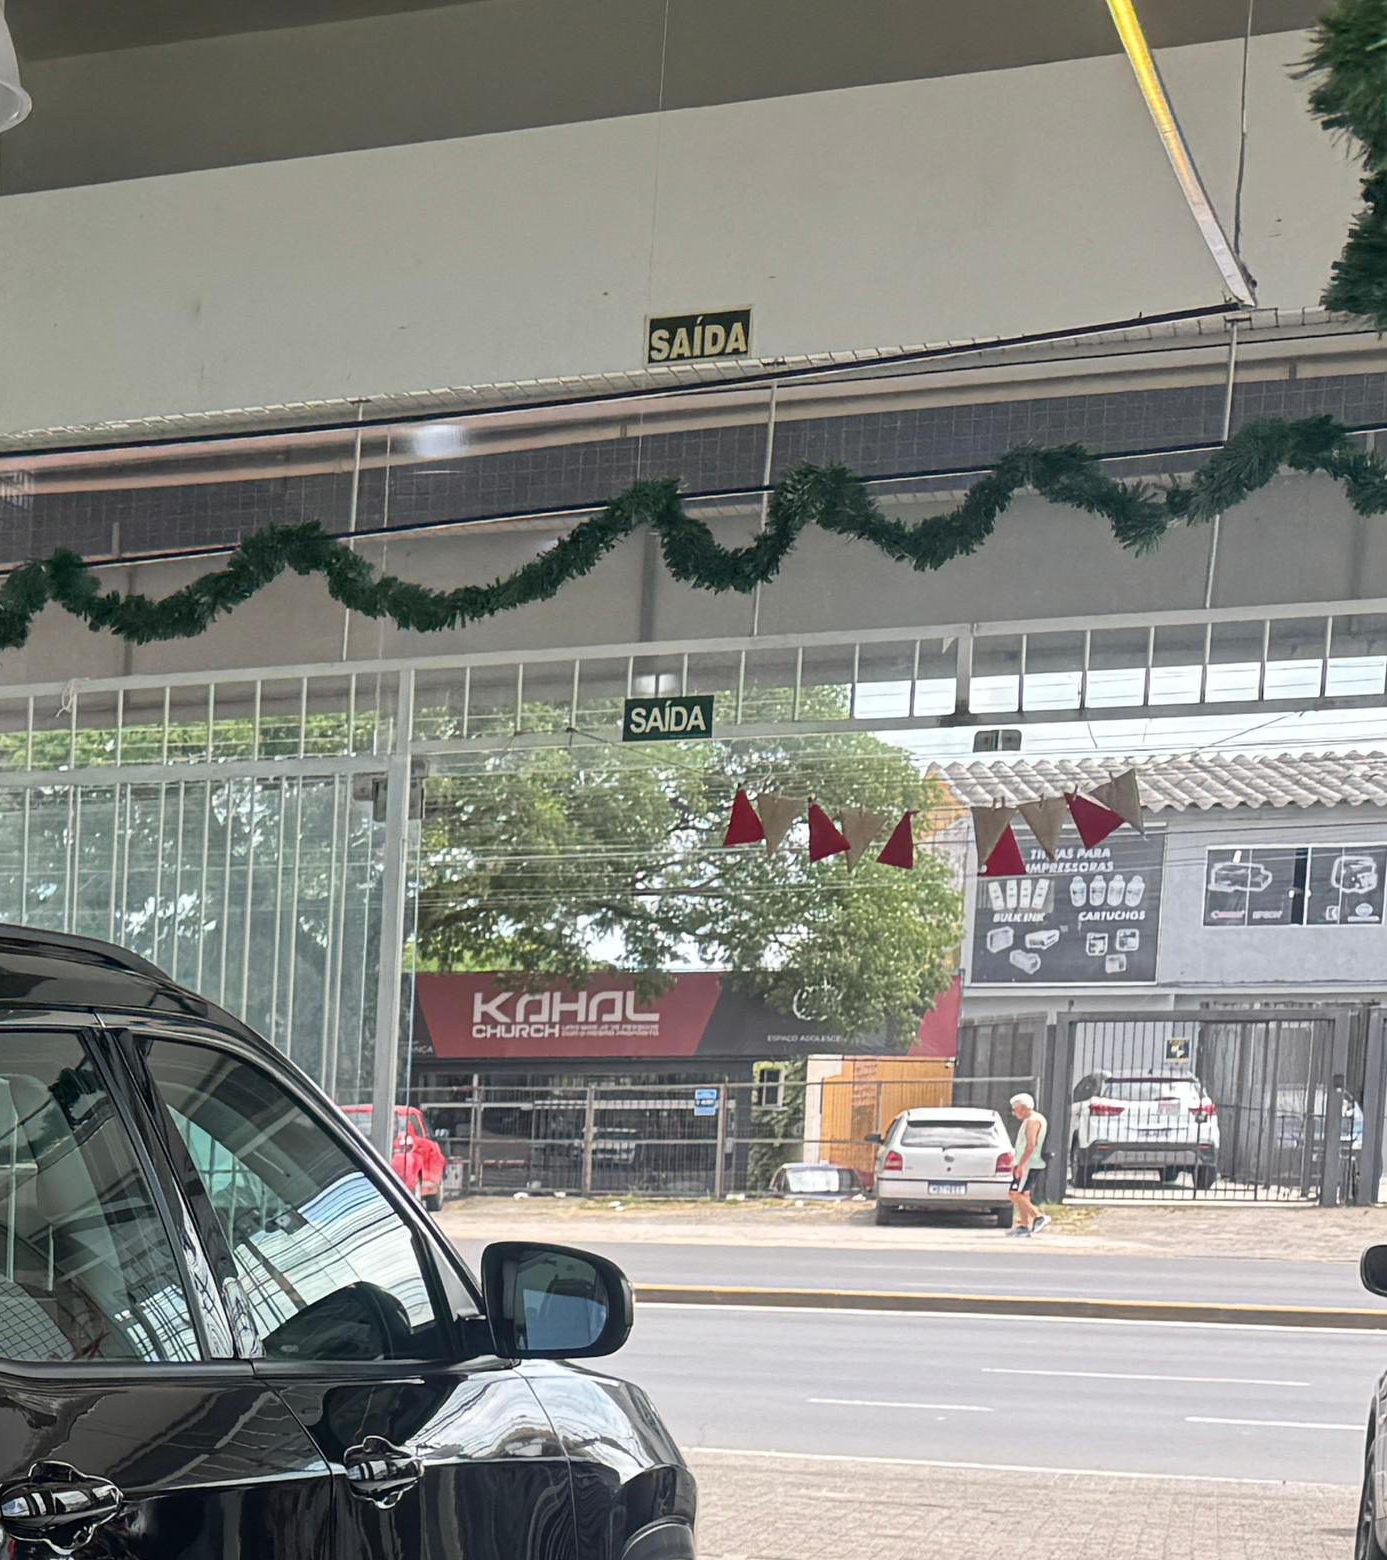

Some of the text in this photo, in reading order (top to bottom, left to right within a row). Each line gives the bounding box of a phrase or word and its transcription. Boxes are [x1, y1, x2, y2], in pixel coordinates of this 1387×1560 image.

[650, 315, 747, 361] SAÍDA
[629, 700, 707, 734] SAÍDA
[1077, 848, 1110, 859] PARA
[993, 912, 1022, 923] BULK
[1078, 910, 1145, 921] CARTUCHOS
[473, 990, 660, 1023] KAHAL
[472, 1023, 560, 1039] CHURCH
